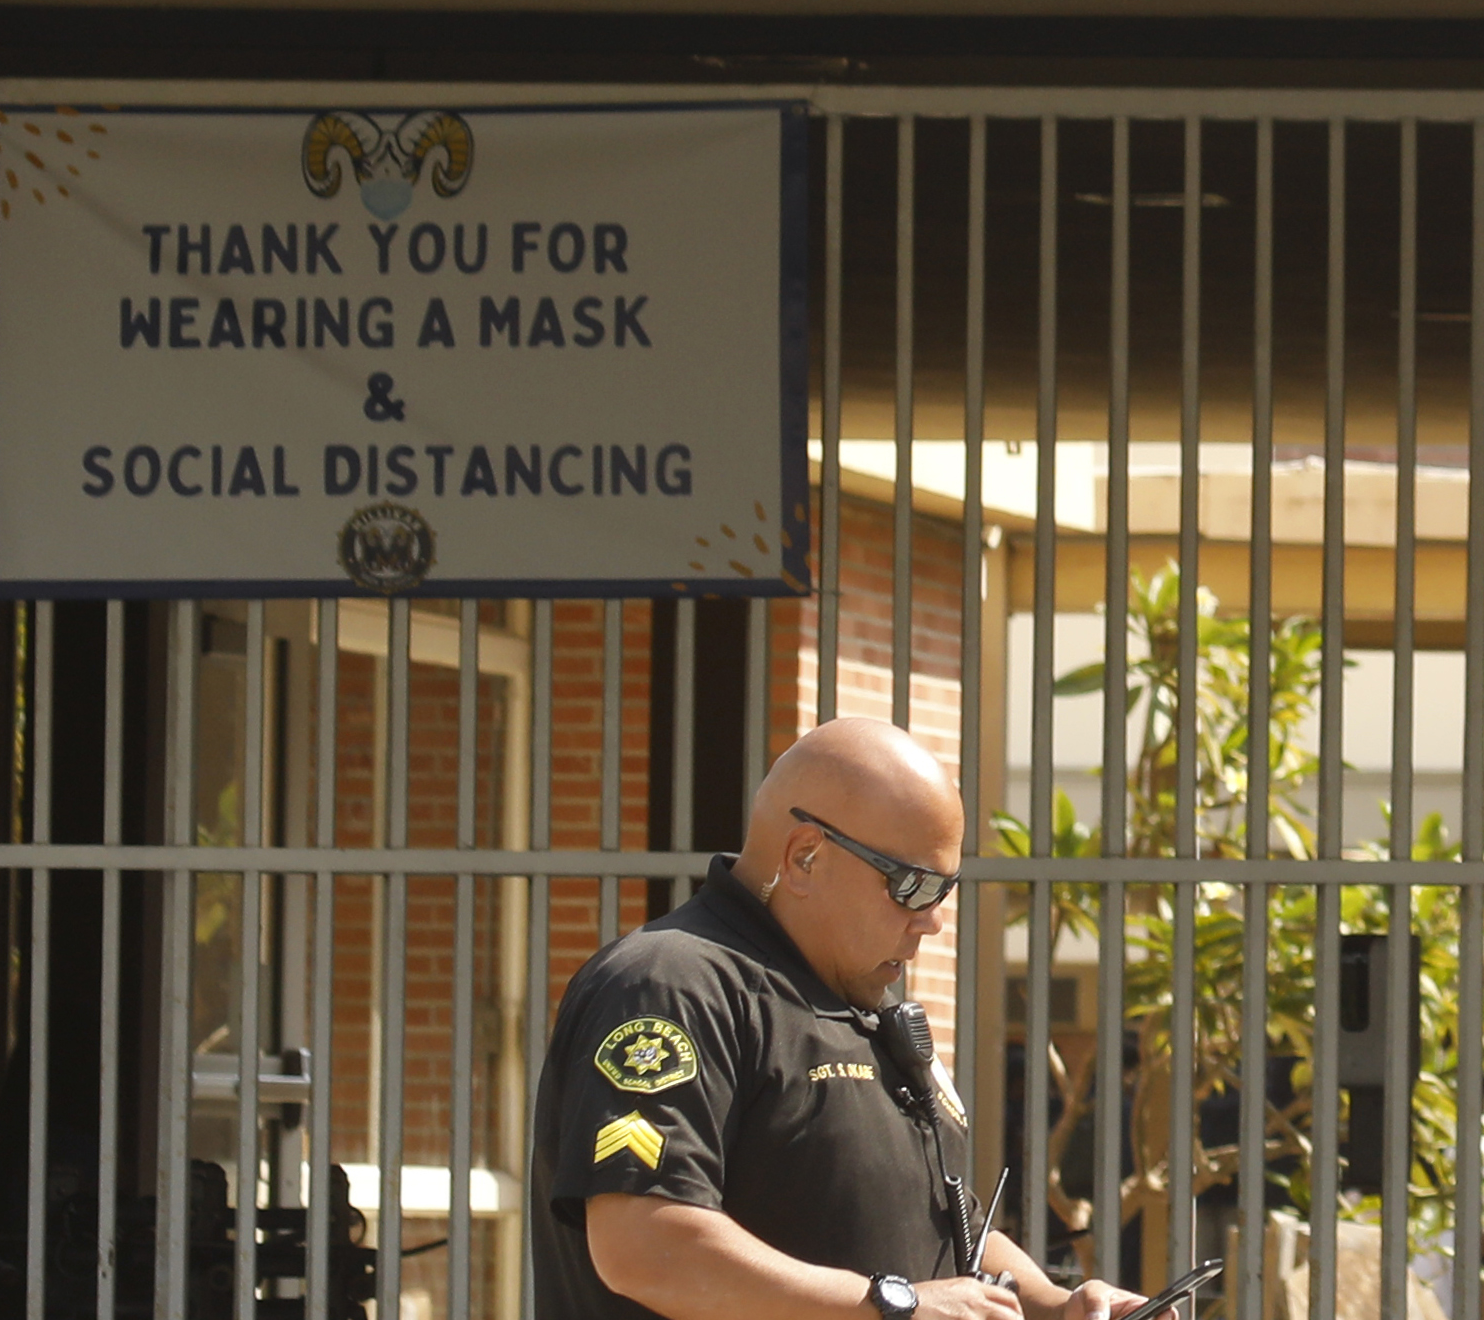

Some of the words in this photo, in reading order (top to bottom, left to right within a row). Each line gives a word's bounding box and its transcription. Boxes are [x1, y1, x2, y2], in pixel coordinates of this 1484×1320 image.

[142, 223, 343, 275] THANK
[367, 222, 489, 275] YOU
[511, 221, 629, 275] FOR
[119, 296, 395, 349] WEARING
[418, 297, 456, 348] A
[478, 295, 652, 348] MASK
[363, 371, 406, 423] &
[82, 445, 300, 497] SOCIAL
[324, 444, 693, 497] DISTANCING
[605, 1020, 646, 1050] LONG
[651, 1021, 693, 1062] BEACH
